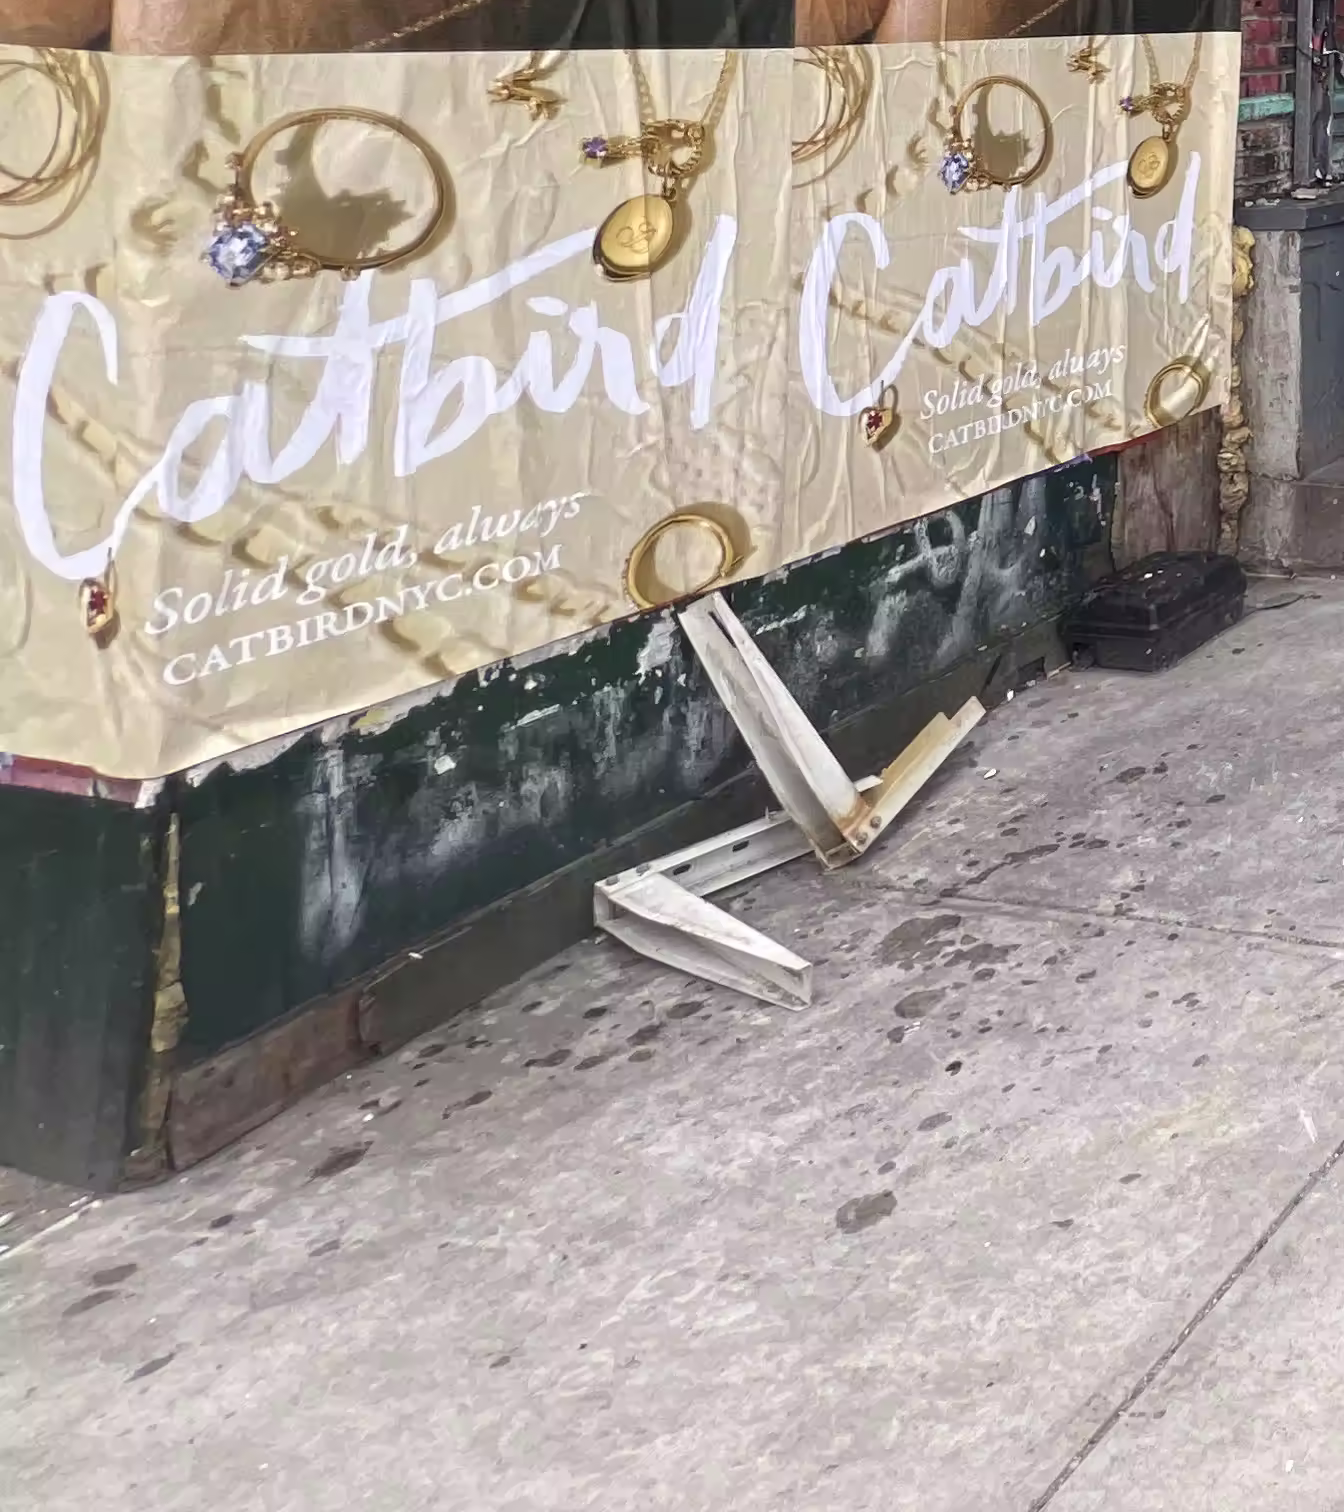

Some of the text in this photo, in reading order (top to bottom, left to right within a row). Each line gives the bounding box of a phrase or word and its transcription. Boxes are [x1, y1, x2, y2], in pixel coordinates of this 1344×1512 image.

[798, 150, 1201, 417] Catbird
[12, 213, 739, 580] Catbird
[919, 373, 985, 420] Solid
[987, 359, 1042, 408] gold,
[144, 492, 584, 636] Solid gold, always
[162, 544, 564, 686] CATBIRDNYC.COM
